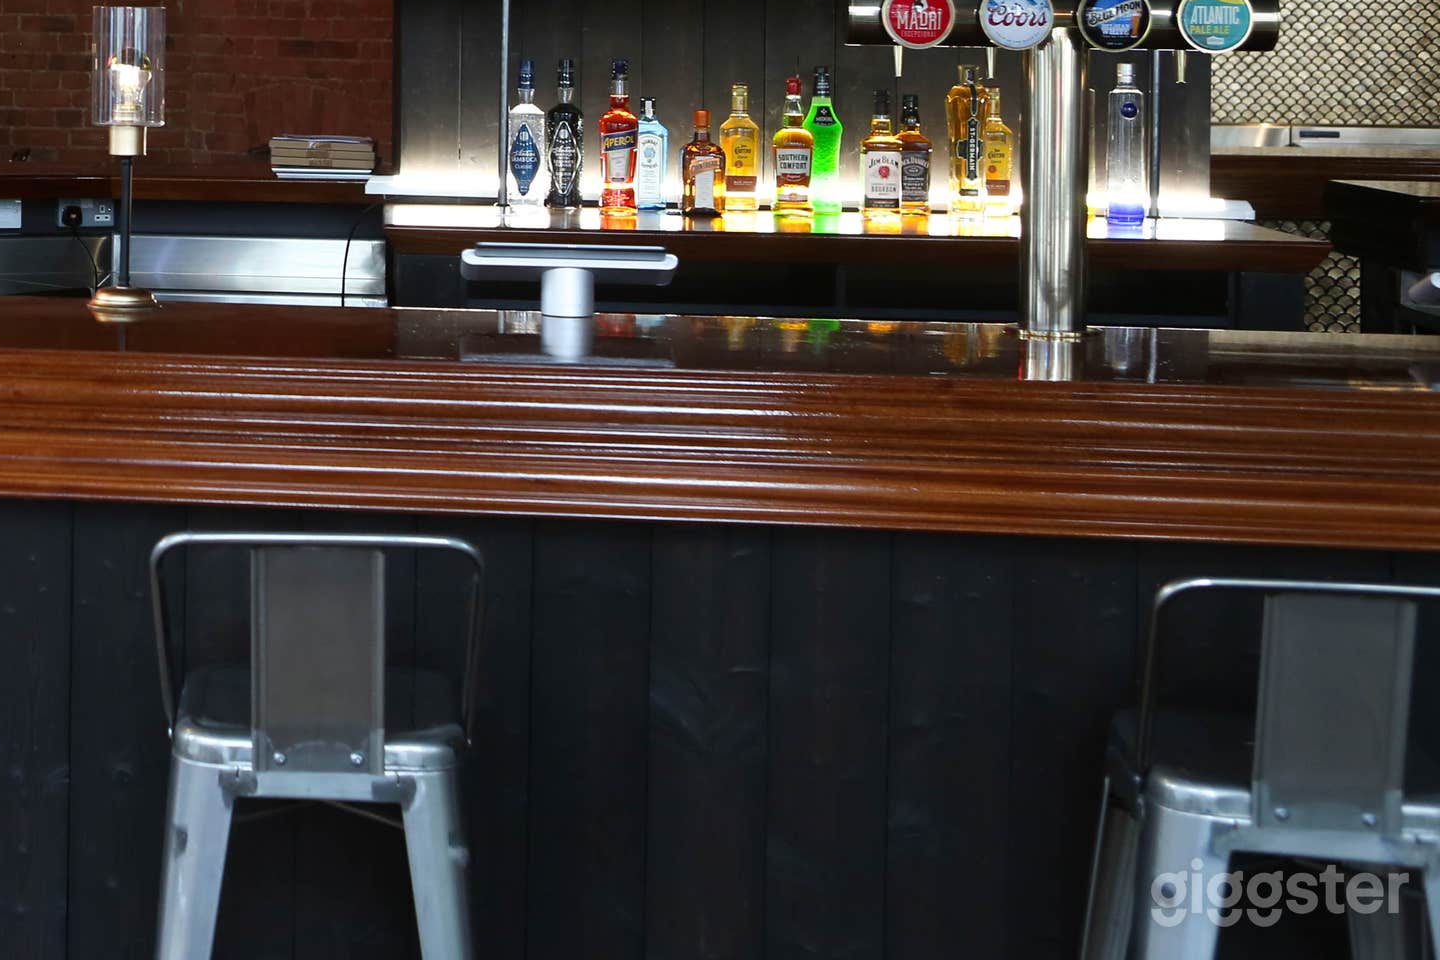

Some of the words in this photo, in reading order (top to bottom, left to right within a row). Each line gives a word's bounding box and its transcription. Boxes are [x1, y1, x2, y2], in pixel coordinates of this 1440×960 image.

[987, 5, 1048, 27] Coors
[1088, 9, 1115, 26] BLUE
[1115, 1, 1141, 15] MOON
[1190, 5, 1241, 25] ATLANTIC
[1190, 25, 1211, 35] PALE
[1213, 25, 1230, 35] ALE
[603, 135, 635, 148] APEROL
[778, 153, 809, 162] SOUTHERN
[868, 158, 881, 168] JIM
